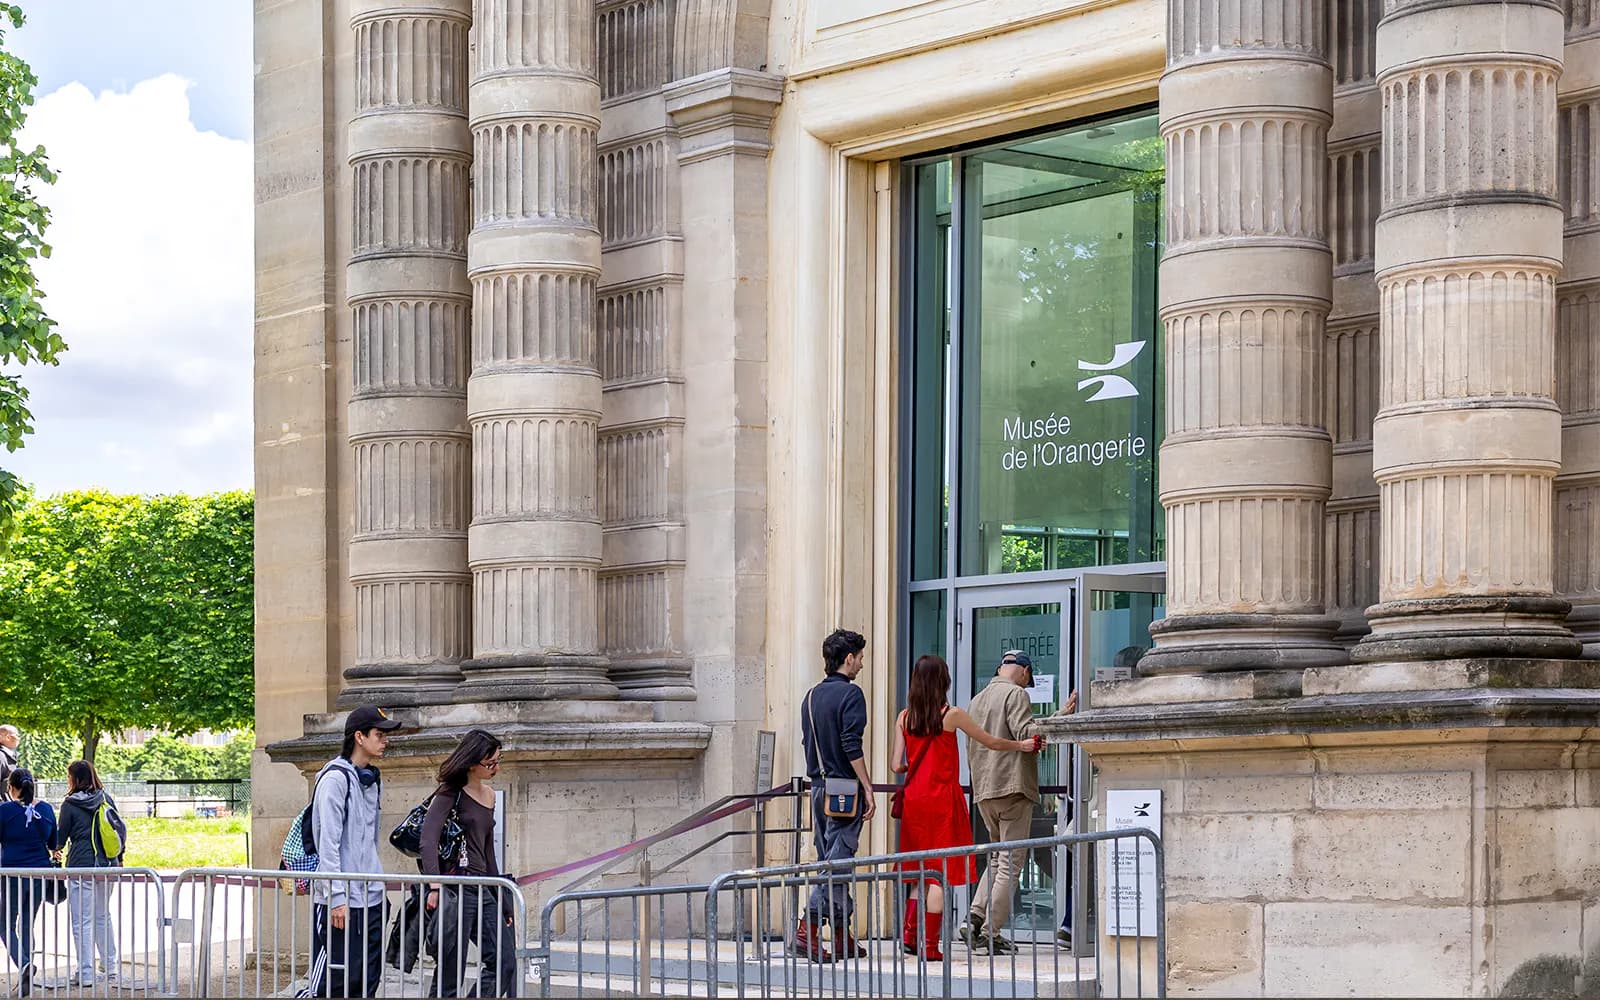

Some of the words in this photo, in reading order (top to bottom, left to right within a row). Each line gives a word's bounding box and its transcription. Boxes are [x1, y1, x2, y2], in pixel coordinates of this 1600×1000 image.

[1003, 412, 1071, 441] Musée
[1002, 446, 1028, 470] de
[1033, 433, 1146, 467] l'Orangerie
[1001, 632, 1054, 658] ENTRÉE
